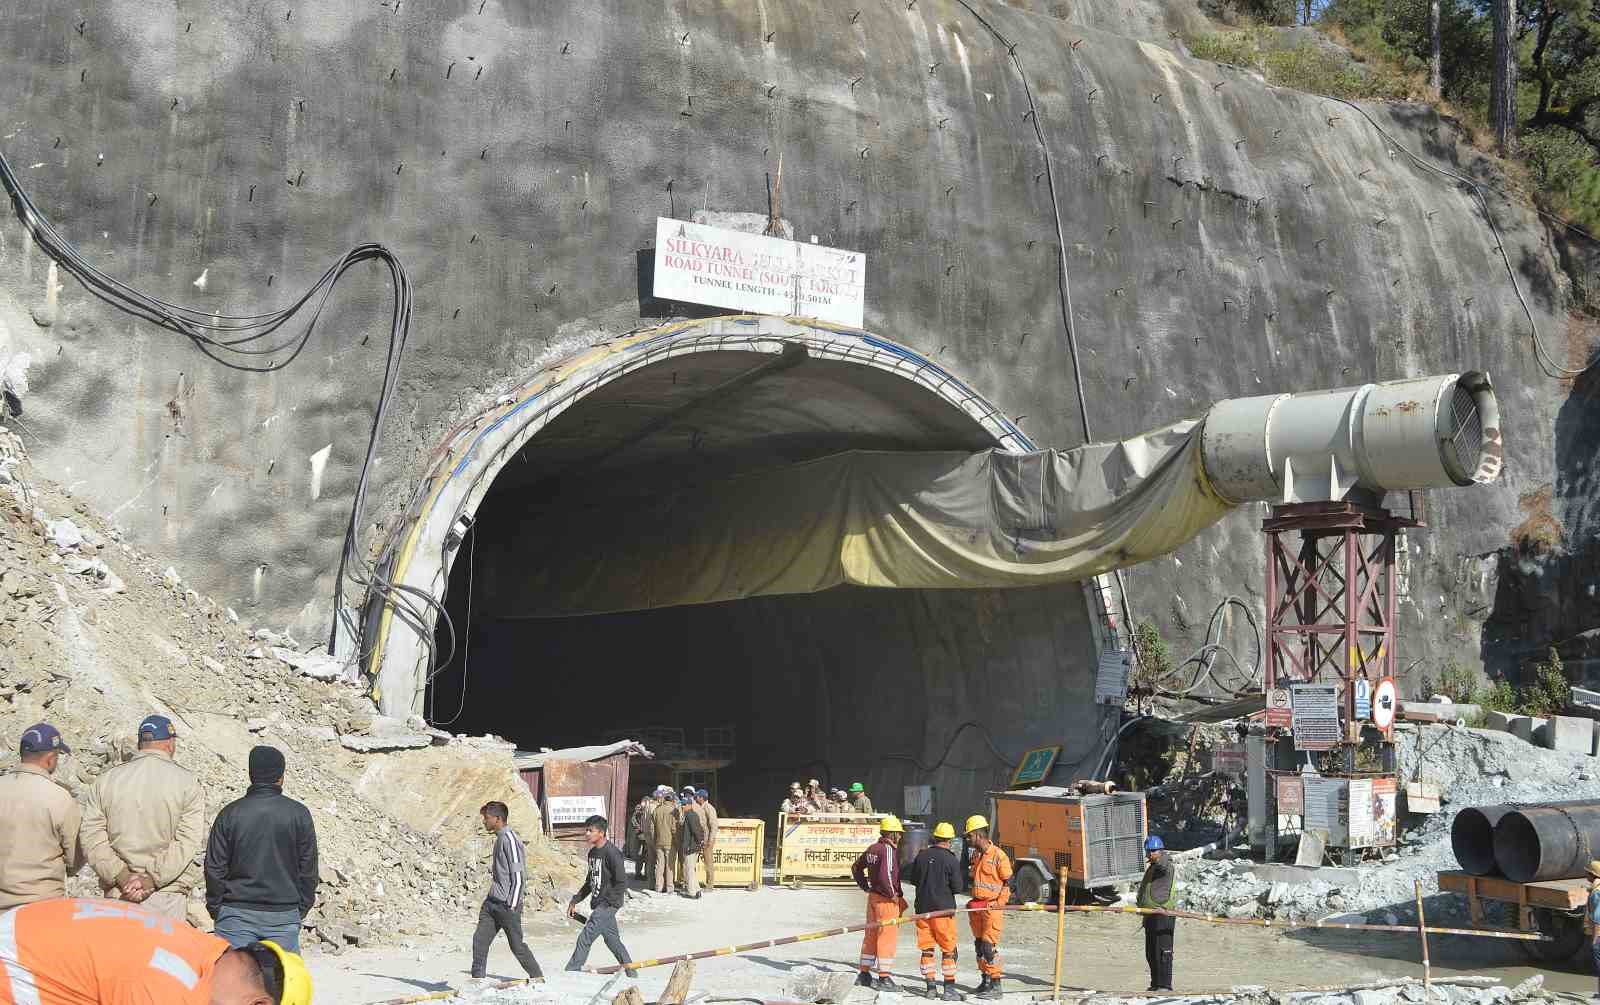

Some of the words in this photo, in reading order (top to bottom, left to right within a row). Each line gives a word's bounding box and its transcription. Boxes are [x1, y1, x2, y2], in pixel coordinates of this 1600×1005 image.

[666, 238, 744, 264] SILKYARA
[664, 255, 703, 272] ROAD
[706, 262, 753, 280] TUNNEL
[759, 271, 806, 290] (SOU
[694, 275, 733, 289] TUNNEL
[736, 282, 775, 296] LENGTH
